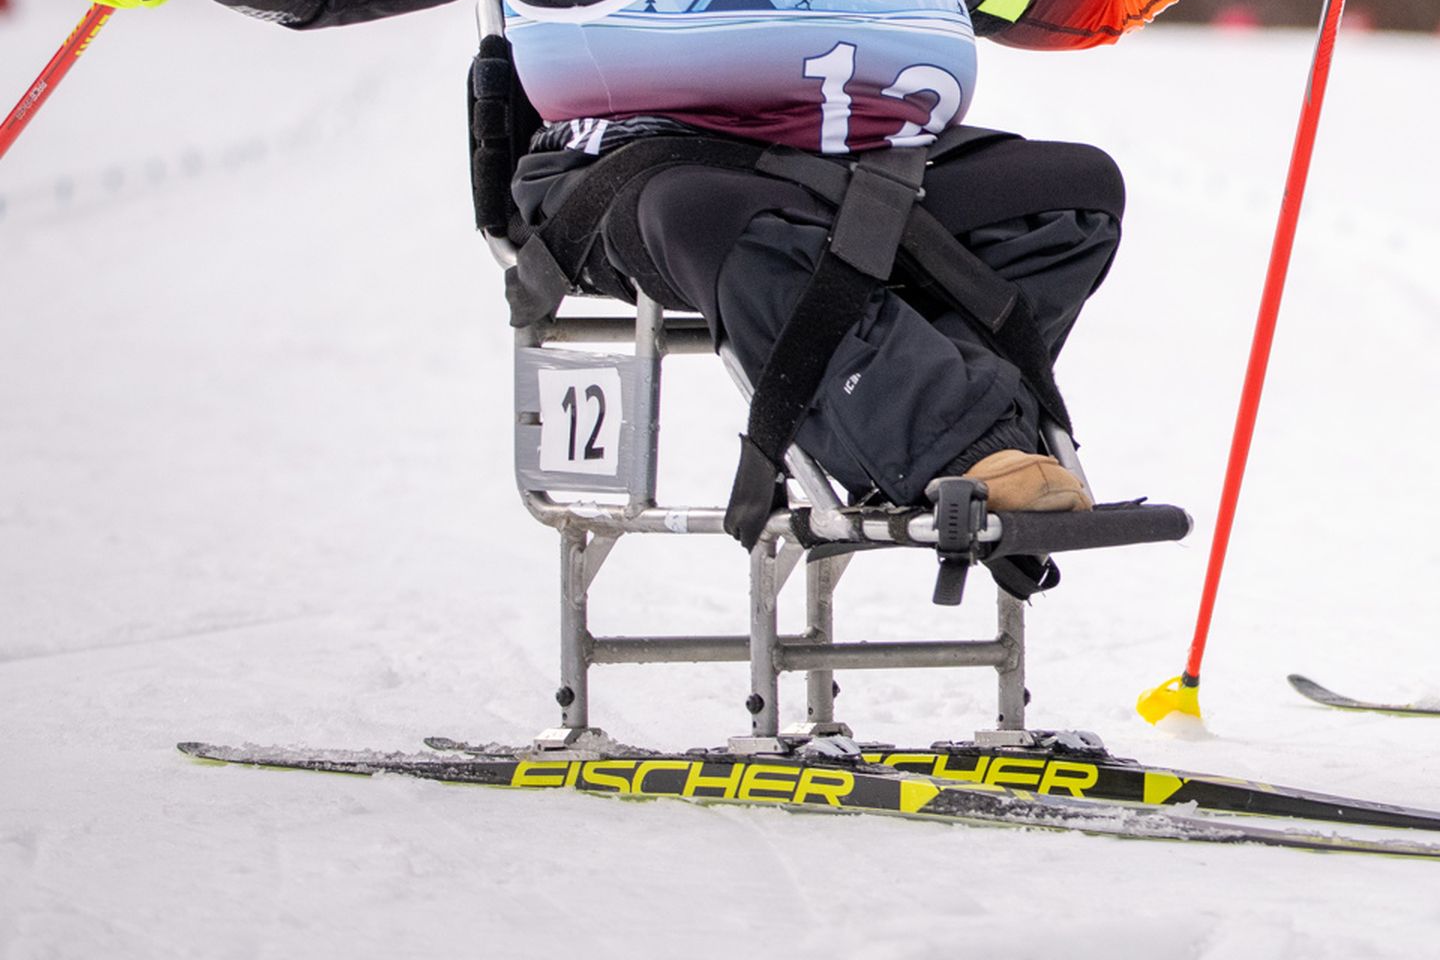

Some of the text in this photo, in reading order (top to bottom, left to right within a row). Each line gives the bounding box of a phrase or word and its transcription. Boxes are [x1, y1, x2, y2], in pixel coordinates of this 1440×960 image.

[802, 41, 963, 154] 12
[561, 384, 606, 461] 12
[511, 760, 856, 808] FISCHER
